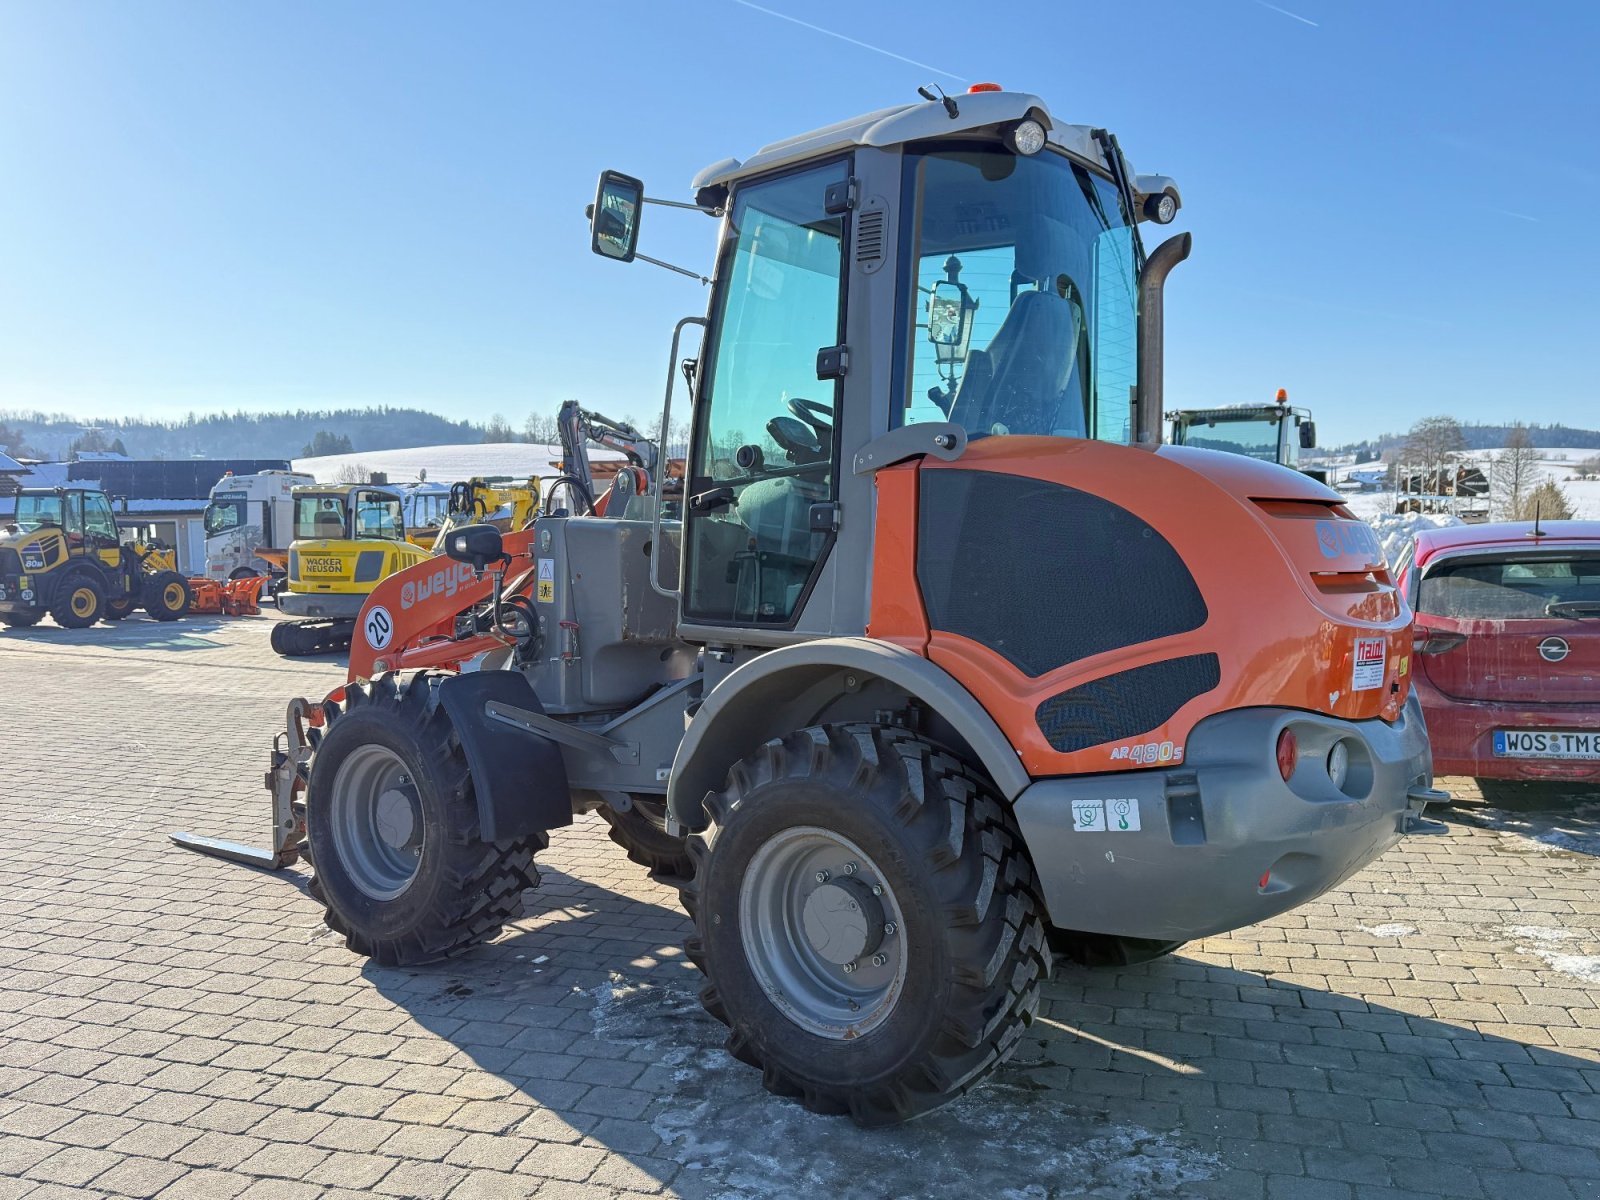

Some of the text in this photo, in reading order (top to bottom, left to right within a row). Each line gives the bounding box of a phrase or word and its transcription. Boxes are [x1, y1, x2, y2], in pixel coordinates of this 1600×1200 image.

[306, 565, 343, 573] NEUSON
[368, 611, 390, 646] 20
[1506, 733, 1547, 752] WOS
